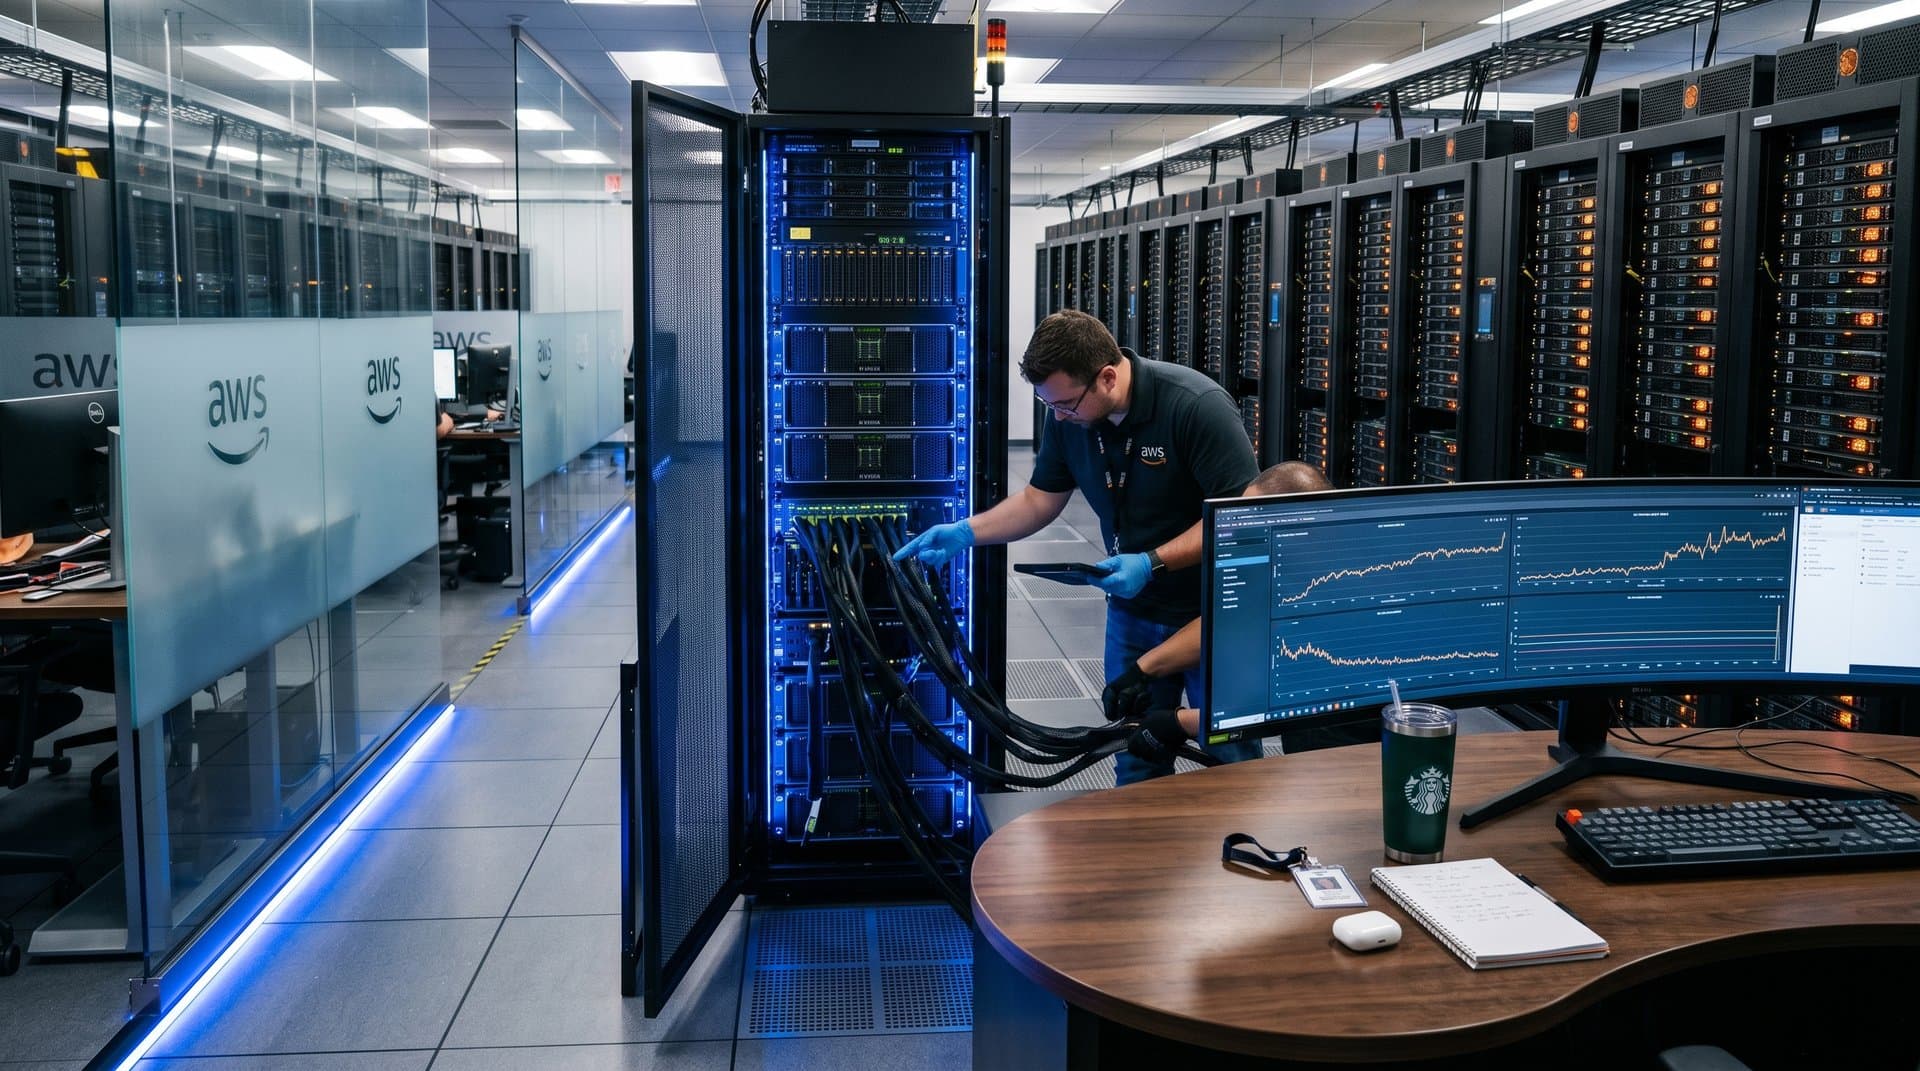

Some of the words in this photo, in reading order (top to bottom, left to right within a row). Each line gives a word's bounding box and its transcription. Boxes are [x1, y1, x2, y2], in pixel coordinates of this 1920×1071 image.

[33, 353, 118, 389] aw
[367, 356, 400, 395] aws
[208, 374, 267, 428] aws
[1141, 446, 1164, 457] aws
